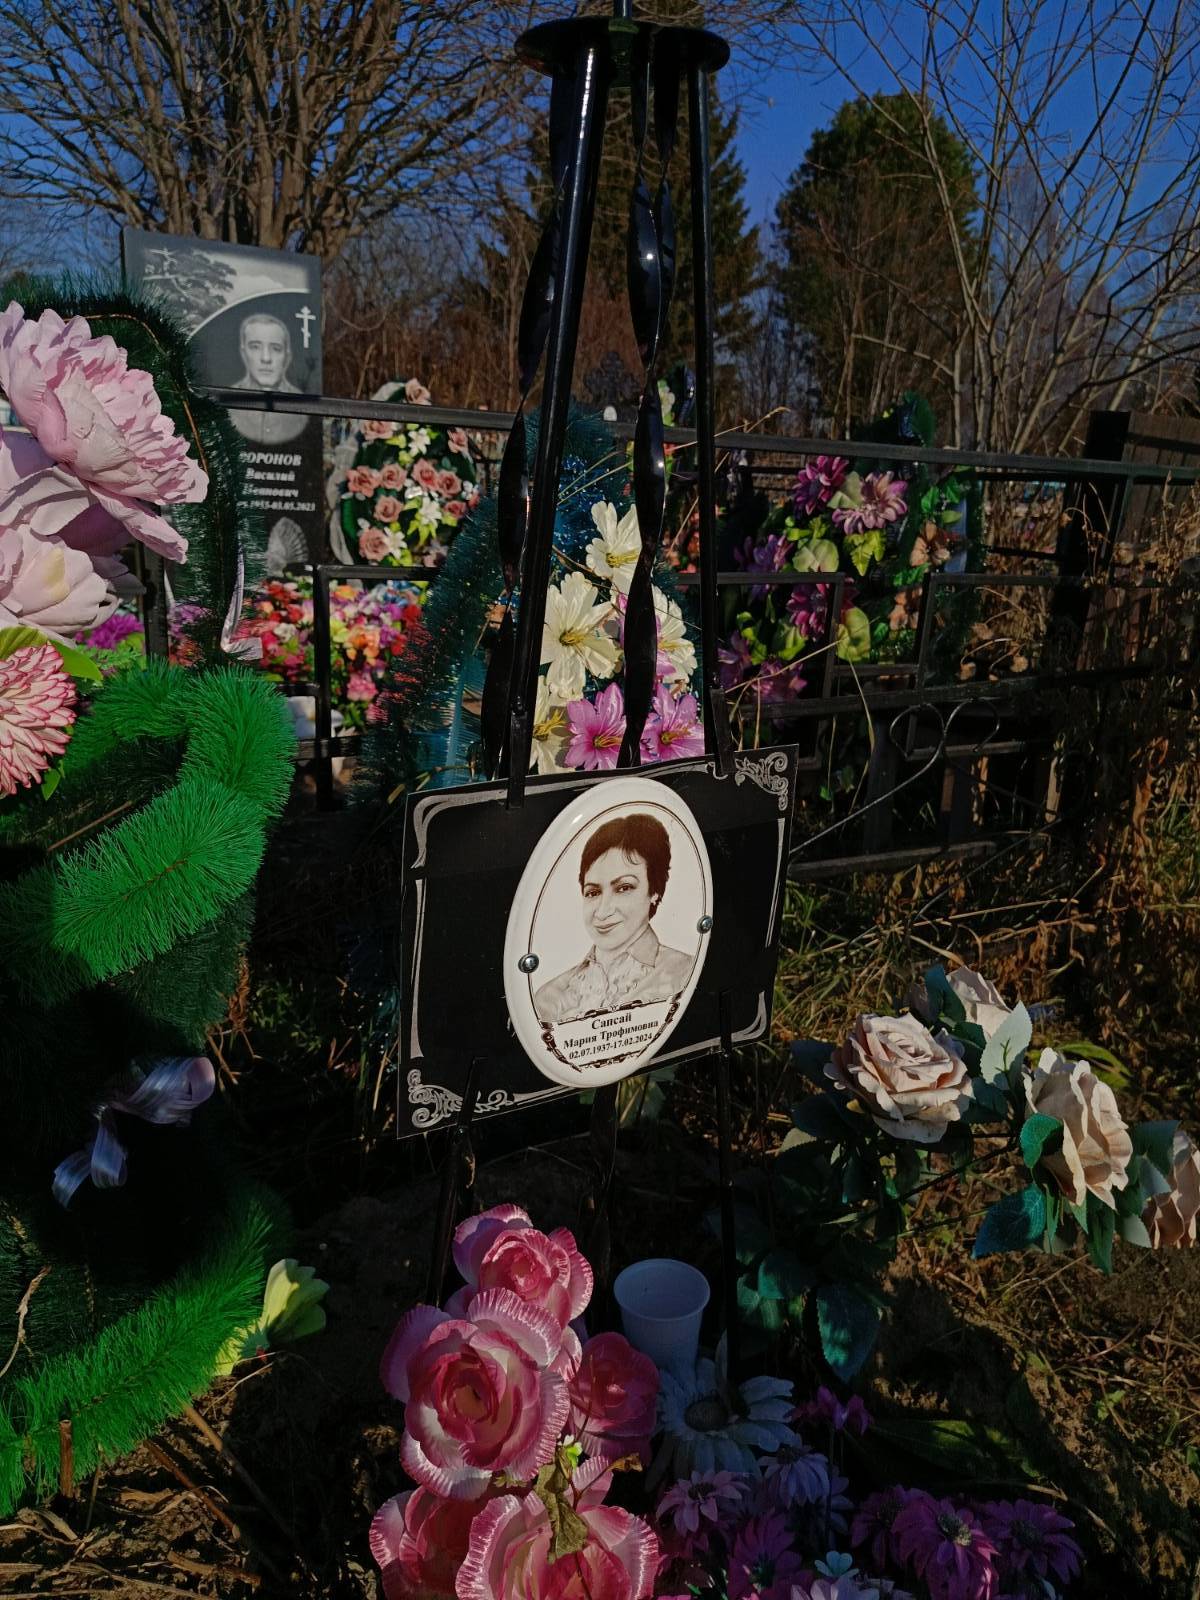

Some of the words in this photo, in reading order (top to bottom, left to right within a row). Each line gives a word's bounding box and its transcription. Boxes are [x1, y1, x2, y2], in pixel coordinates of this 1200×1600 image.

[591, 1012, 632, 1029] Сапсай
[563, 1034, 597, 1049] Мария
[600, 1020, 659, 1041] Трофимовна
[569, 1033, 653, 1059] 02.07.1937-17.02.2024
